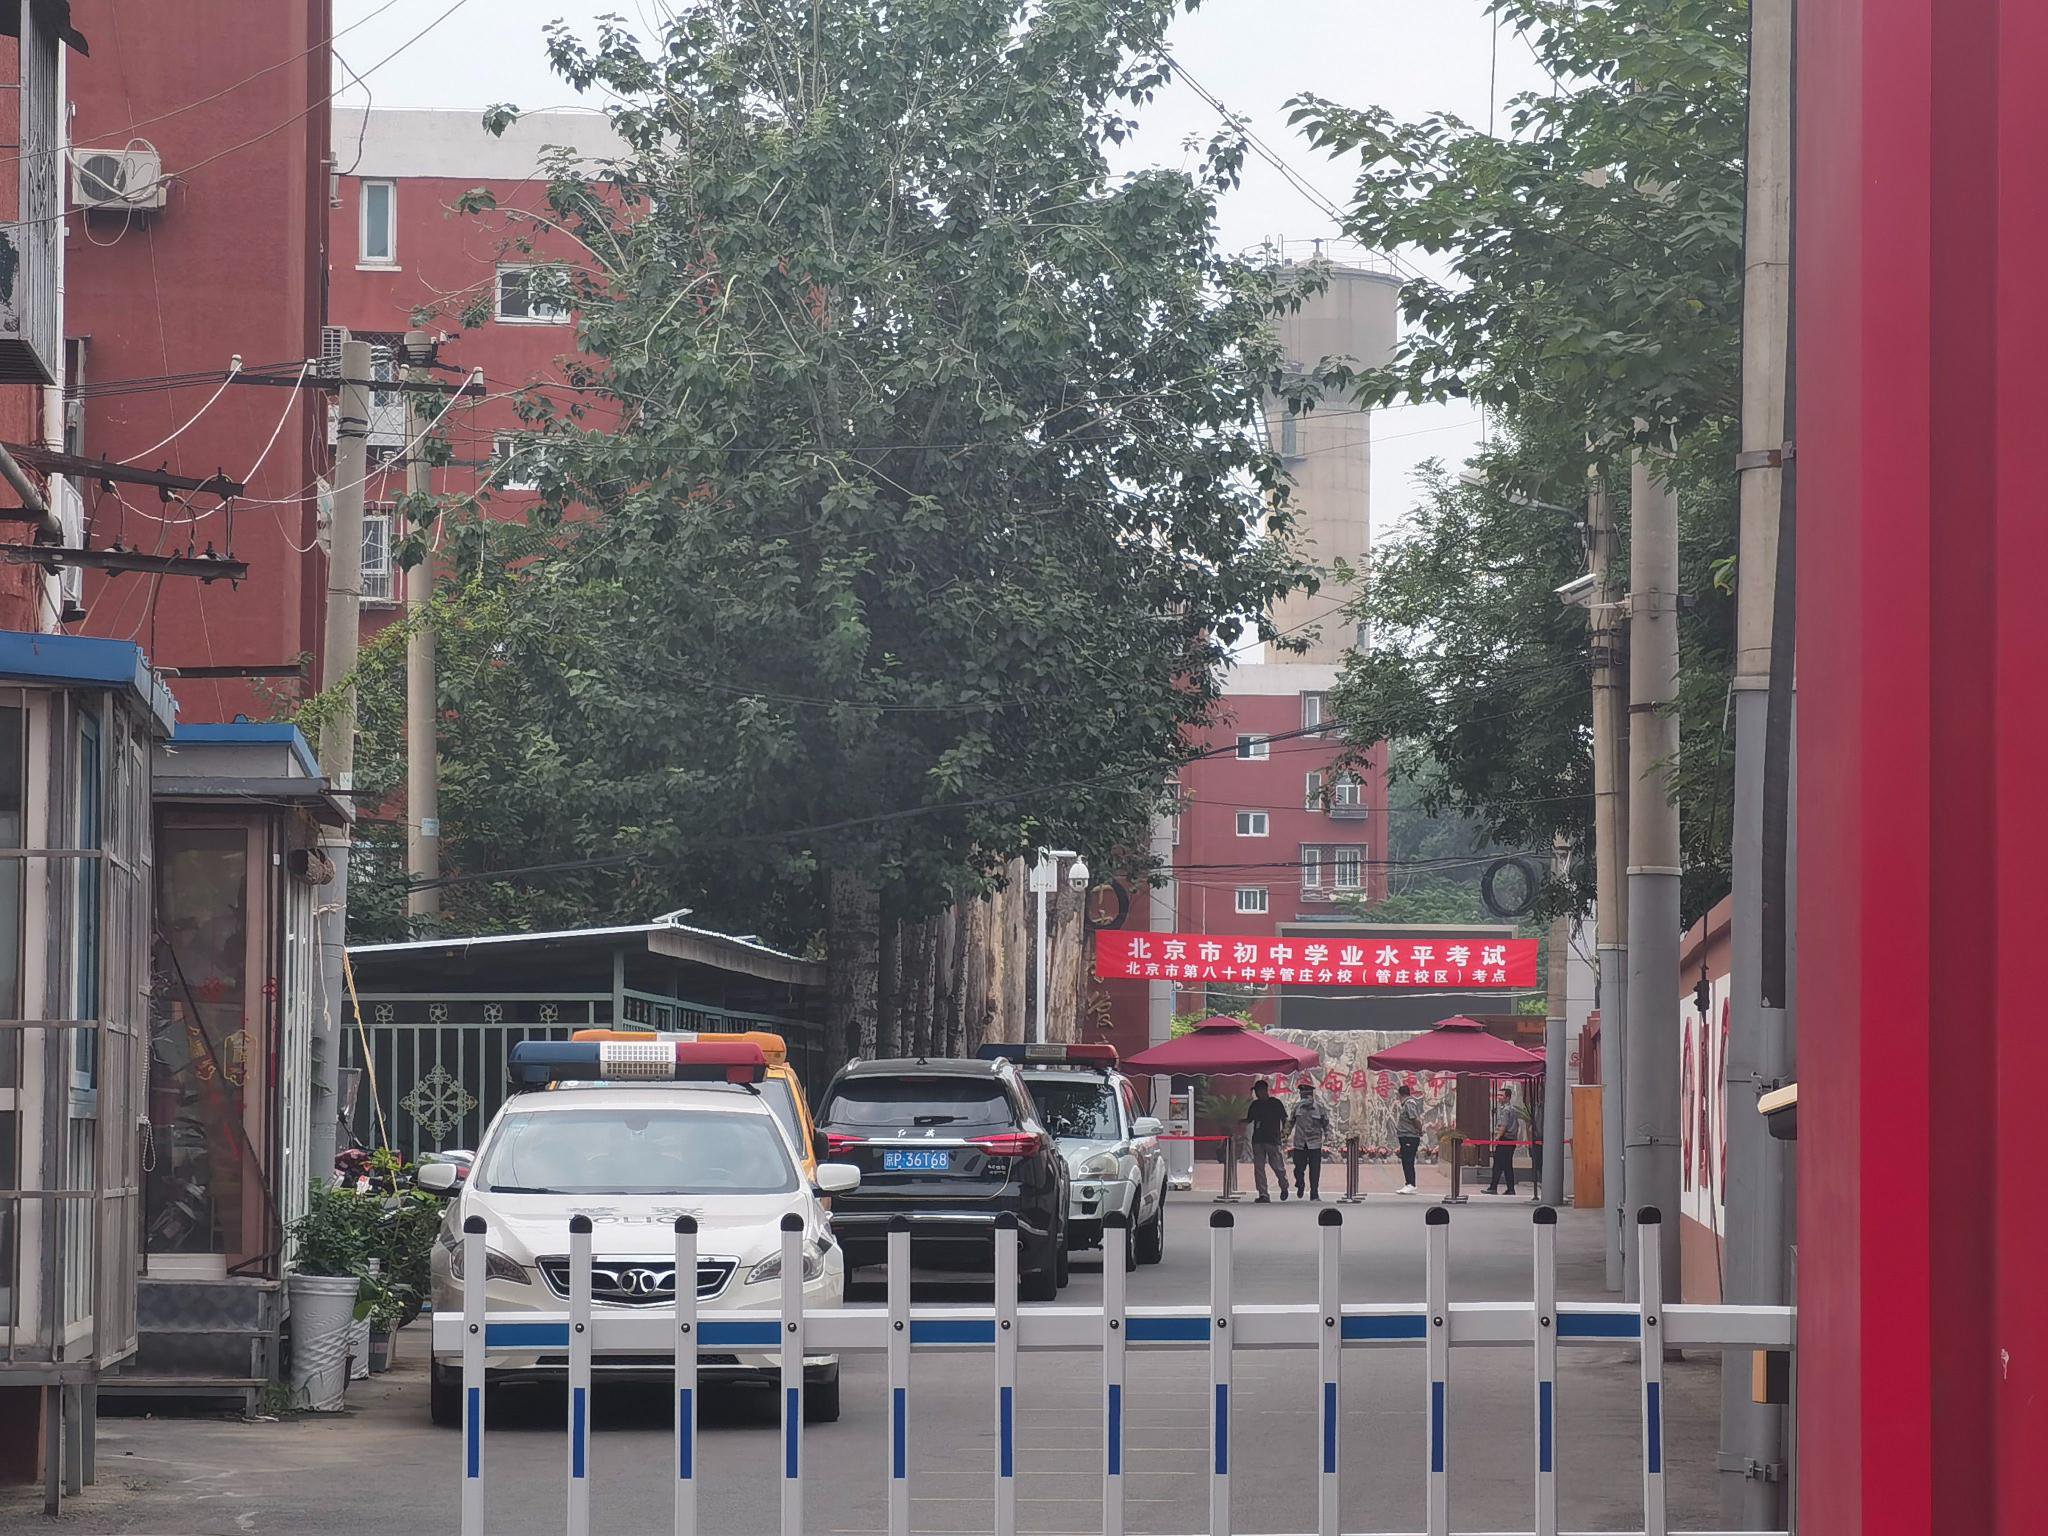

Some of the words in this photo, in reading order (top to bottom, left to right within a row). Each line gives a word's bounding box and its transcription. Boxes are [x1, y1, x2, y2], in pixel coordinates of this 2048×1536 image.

[1128, 938, 1506, 967] 北京市初中学业水平考试
